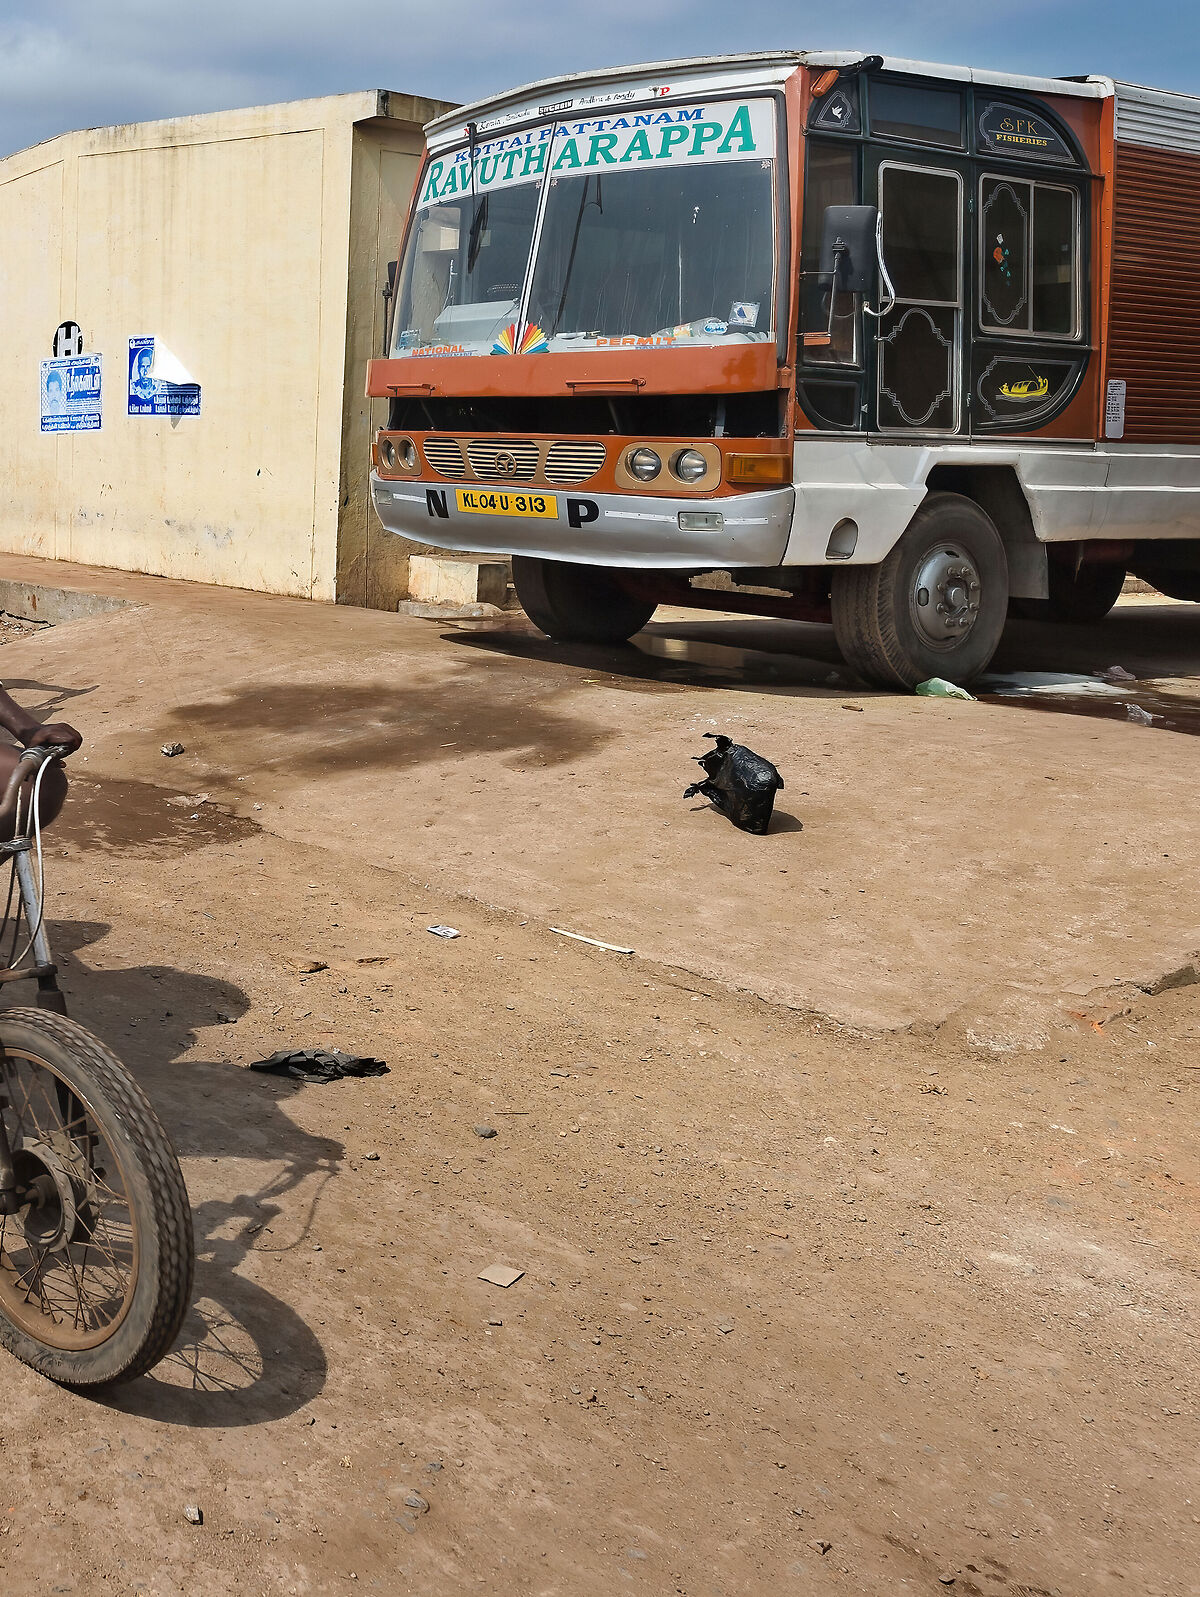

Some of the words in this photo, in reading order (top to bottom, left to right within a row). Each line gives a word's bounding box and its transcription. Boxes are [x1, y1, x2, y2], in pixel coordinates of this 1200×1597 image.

[659, 86, 671, 97] P
[454, 132, 534, 163] KOTTAI
[539, 108, 705, 141] PATTANAM
[995, 133, 1048, 147] FISHERIES
[411, 344, 465, 357] NATIONAL
[596, 336, 677, 347] PERMIT
[426, 489, 450, 519] N
[566, 498, 600, 529] P
